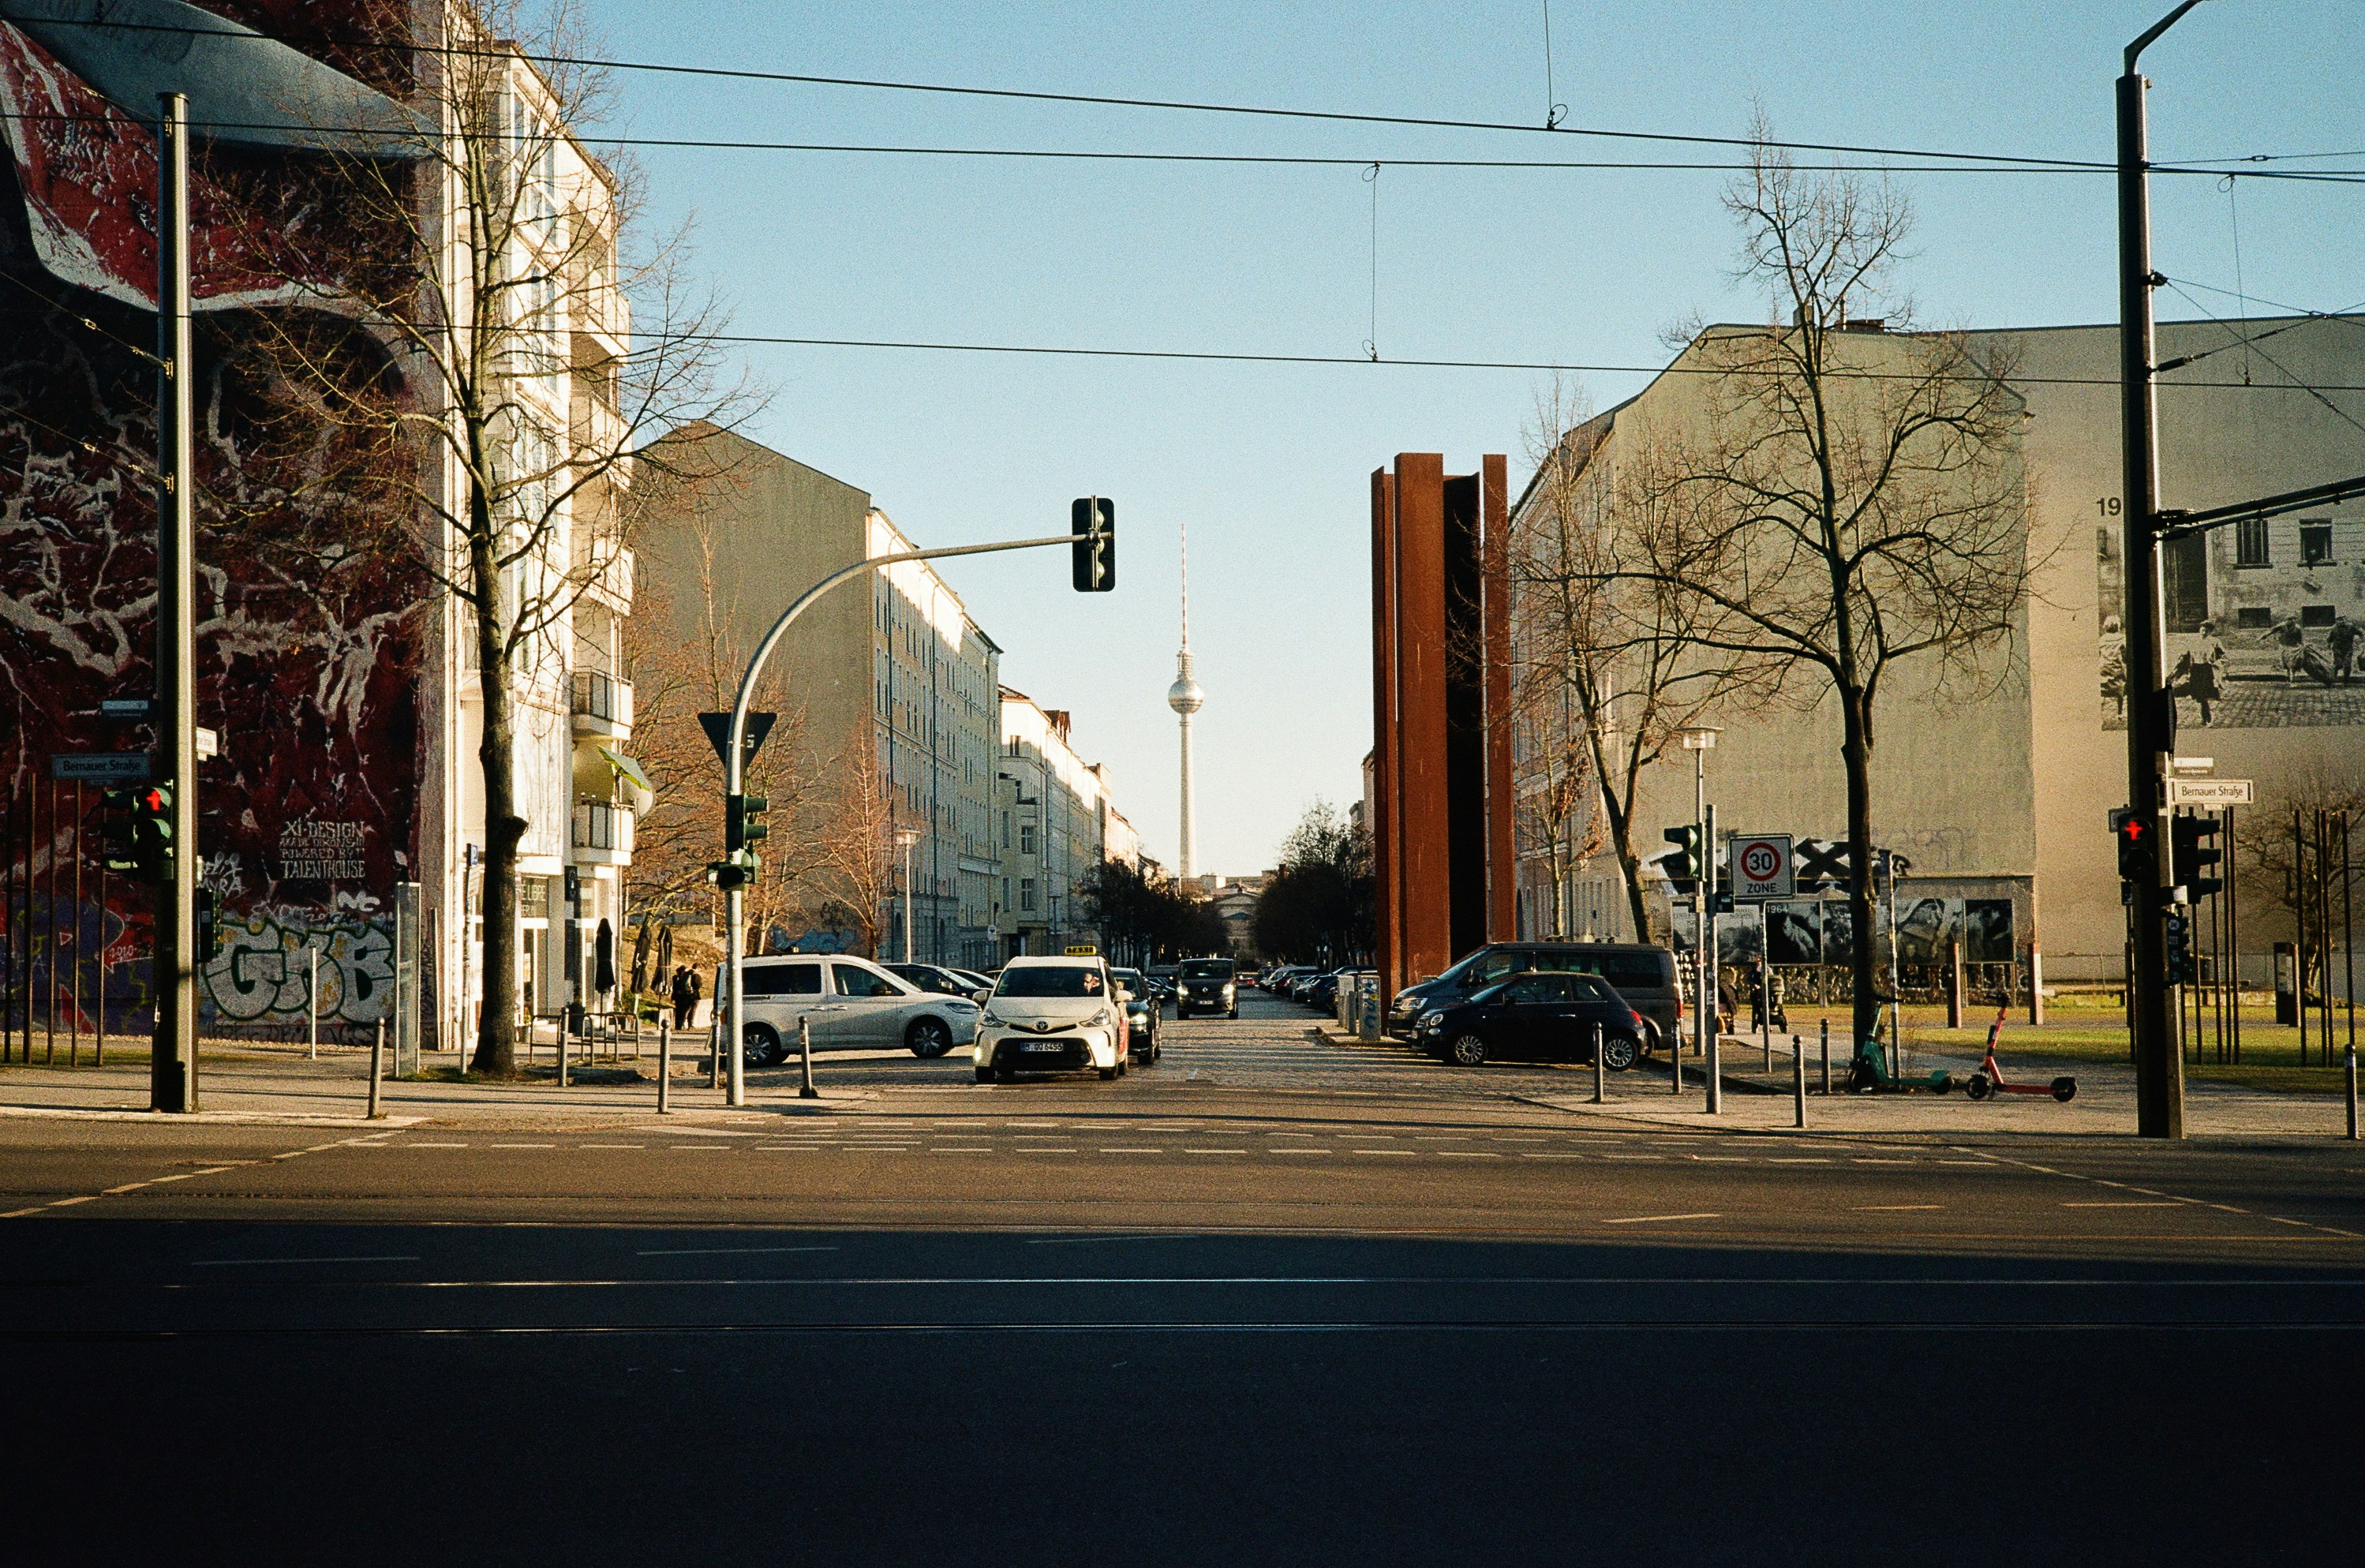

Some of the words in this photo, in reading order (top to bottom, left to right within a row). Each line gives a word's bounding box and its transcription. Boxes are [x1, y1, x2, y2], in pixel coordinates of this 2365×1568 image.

[2096, 497, 2122, 516] 19
[63, 760, 107, 772] Bernauer
[109, 759, 141, 773] Straße
[2181, 785, 2217, 796] Bernauer
[2218, 785, 2243, 799] Straße
[279, 848, 335, 859] POWERED
[1749, 852, 1773, 871] 30
[280, 860, 366, 879] TALENTHOUSE
[1746, 883, 1777, 893] ZONE
[1766, 904, 1788, 914] 1964
